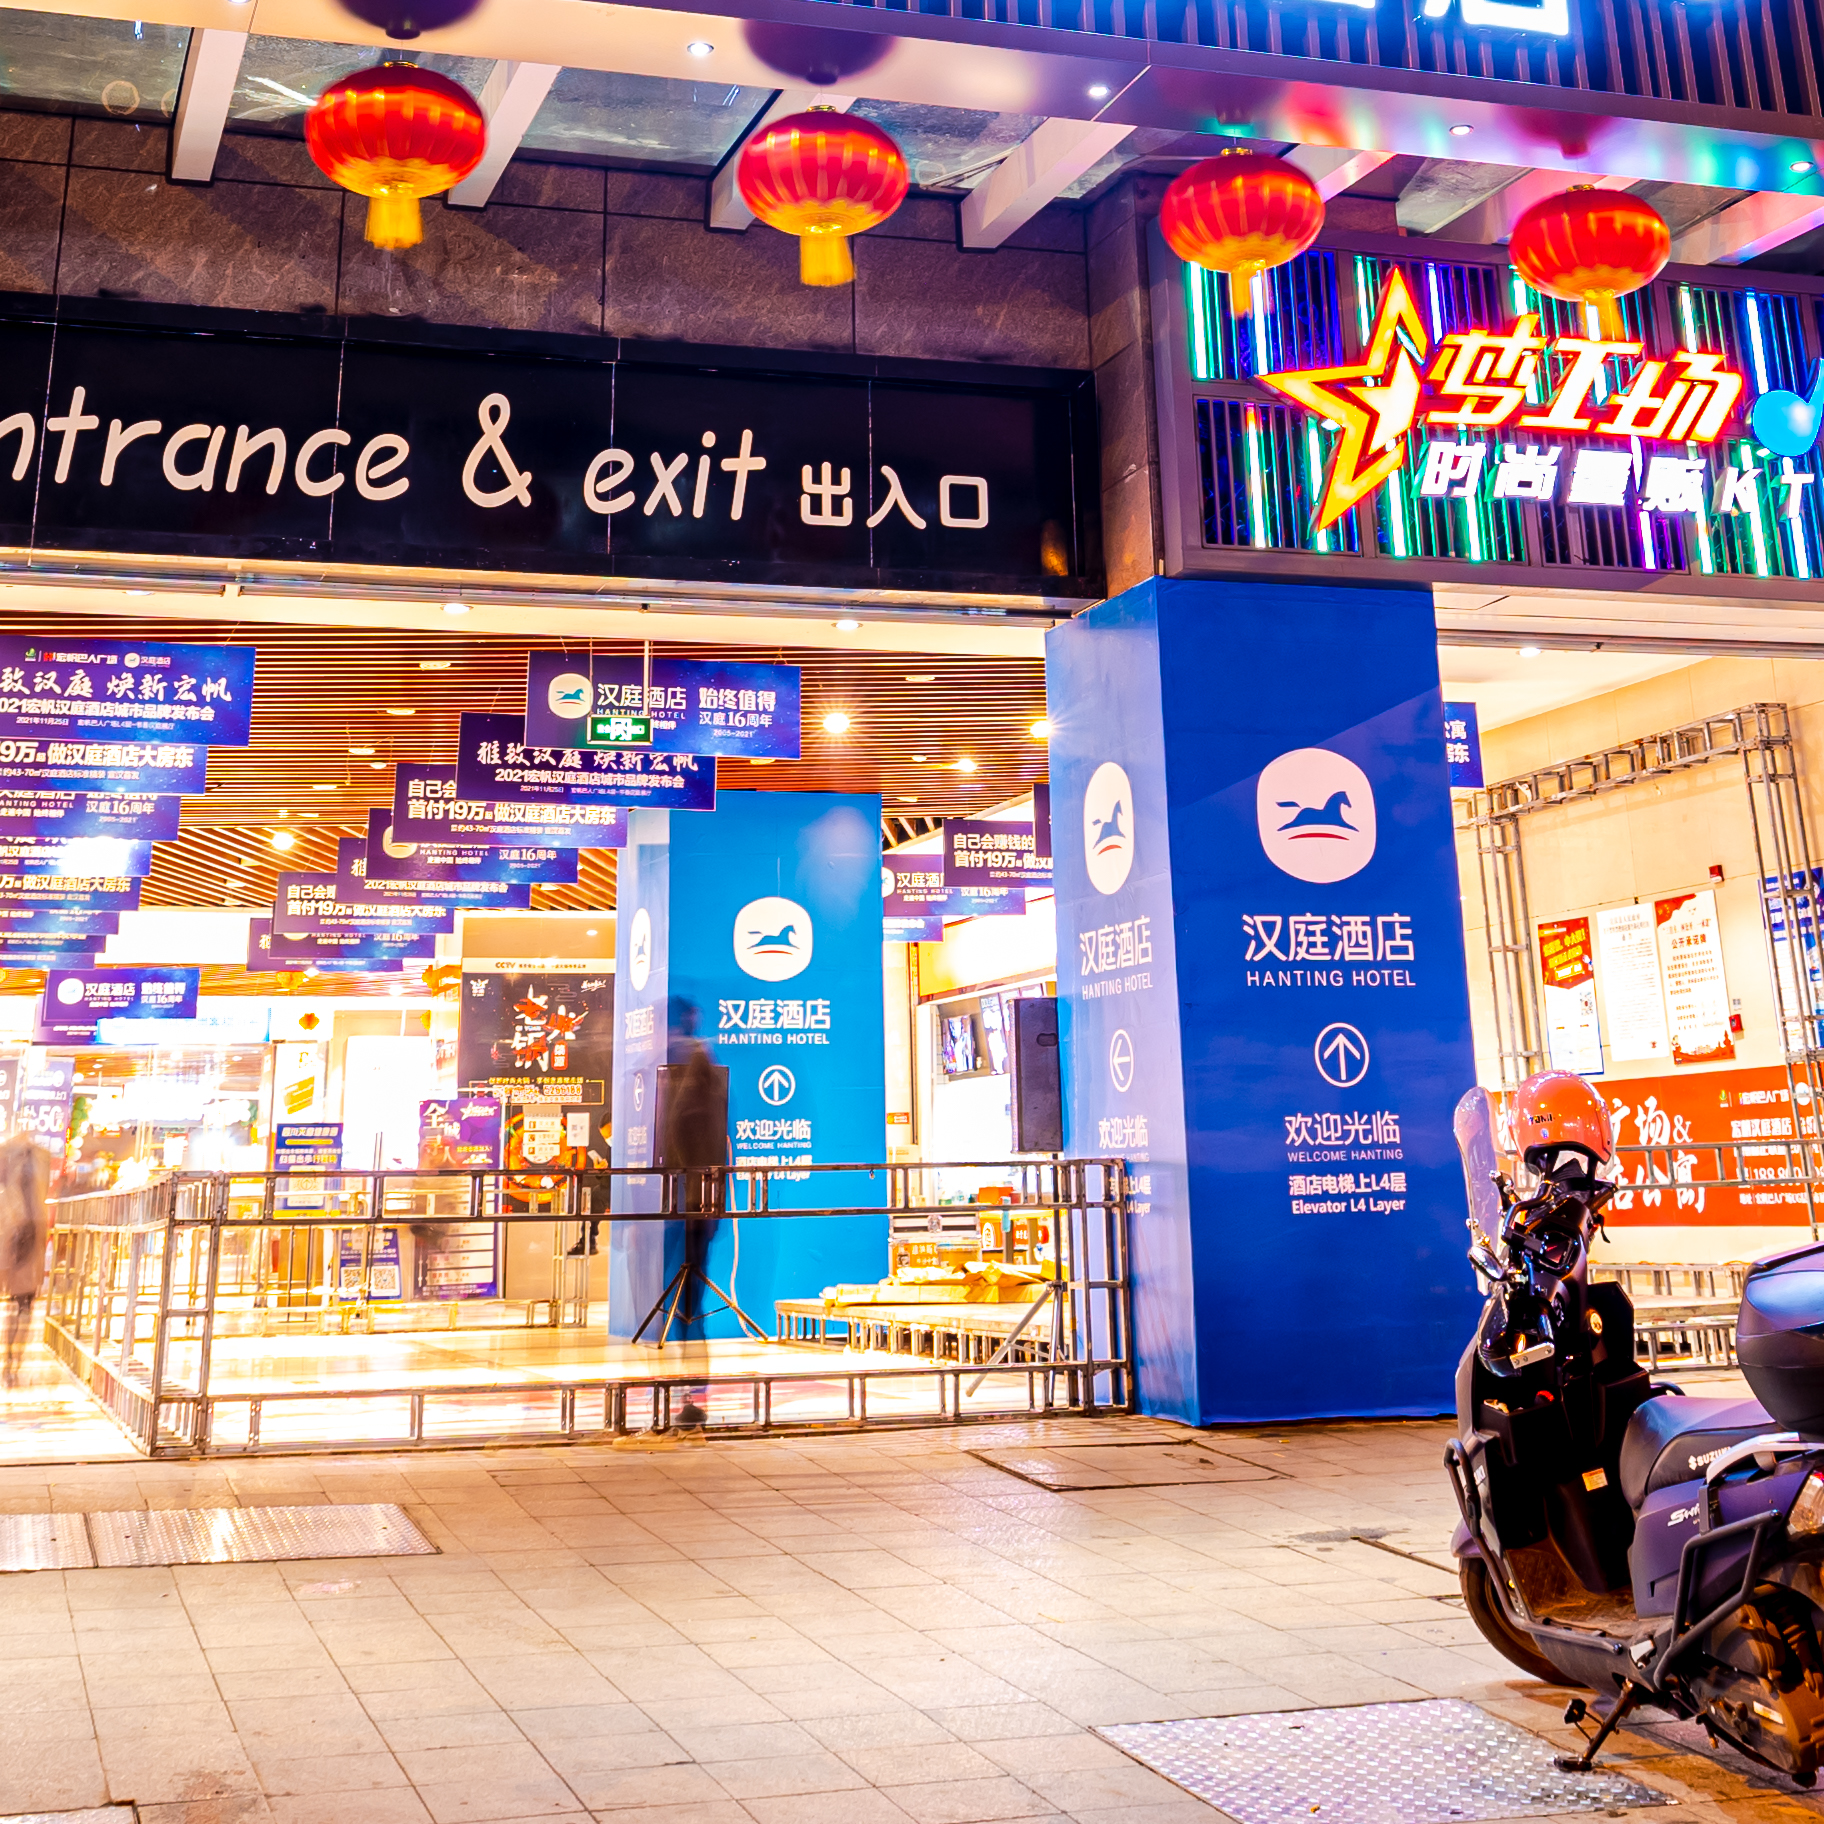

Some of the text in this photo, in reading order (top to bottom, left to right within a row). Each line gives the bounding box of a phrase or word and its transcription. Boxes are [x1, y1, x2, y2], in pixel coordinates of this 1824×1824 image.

[1425, 312, 1744, 443] 梦工场
[461, 392, 534, 509] &
[582, 426, 768, 522] exit
[797, 461, 990, 530] 出入口
[106, 673, 233, 703] 焕新宏帆
[597, 683, 777, 712] 汉庭酒店 始终值得
[699, 710, 774, 729] 汉庭16周年
[41, 801, 74, 809] HOTEL
[86, 800, 155, 816] 汉庭16周年
[1079, 914, 1154, 978] 汉庭酒店
[1241, 911, 1416, 963] 汉庭酒店
[1081, 973, 1154, 1001] HANTING HOTEL
[1246, 969, 1417, 988] HANTING HOTEL
[717, 997, 832, 1031] 汉庭酒店
[718, 1033, 831, 1045] HANTING HOTEL
[735, 1118, 812, 1141] 欢迎光临
[1098, 1113, 1150, 1150] 欢迎光临
[1284, 1110, 1402, 1147] 欢迎光临
[1287, 1147, 1404, 1163] WELCOME HANTING
[1288, 1172, 1408, 1196] 酒店电梯上L4层
[1291, 1196, 1407, 1217] Elevator L4 Layer
